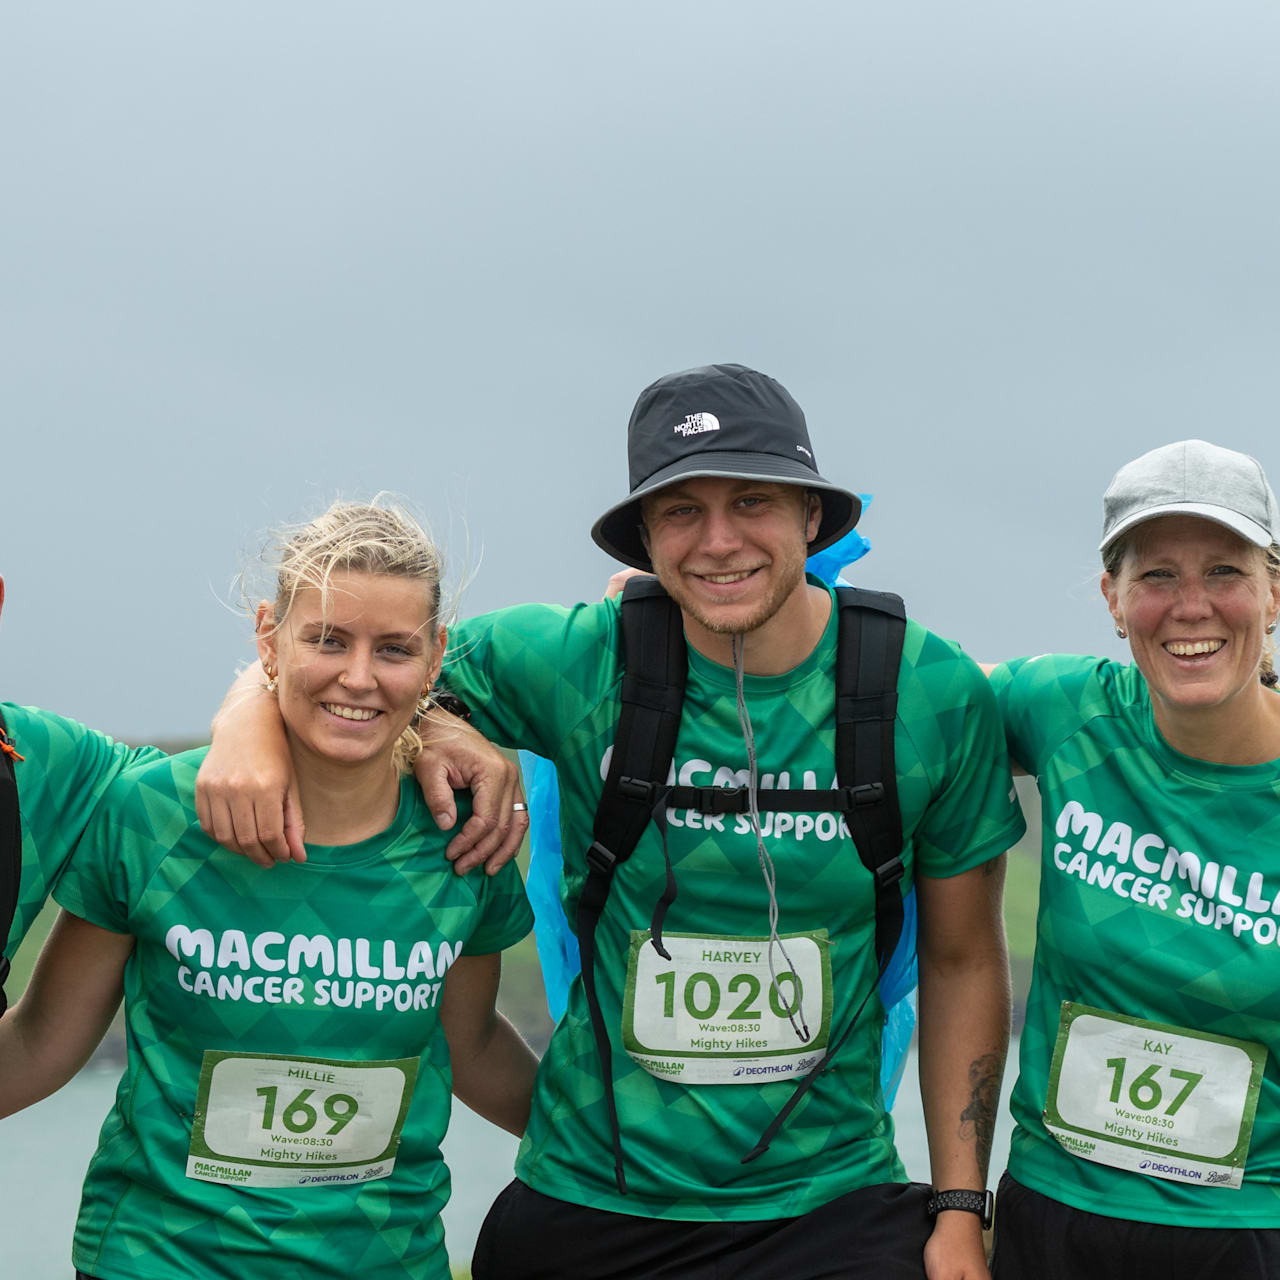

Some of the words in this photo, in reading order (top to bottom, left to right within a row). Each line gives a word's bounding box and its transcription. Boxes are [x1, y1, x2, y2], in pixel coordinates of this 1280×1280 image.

[674, 418, 703, 433] NORTH
[685, 413, 703, 423] THE
[682, 426, 704, 437] FACE
[666, 806, 726, 832] CER
[734, 808, 853, 842] SUPPOR
[1054, 841, 1172, 909] CANCER
[165, 923, 464, 982] MACMILLAN
[702, 950, 762, 963] HARVEY
[177, 965, 305, 1006] CANCER
[313, 978, 442, 1013] SUPPORT
[655, 970, 804, 1021] 1020
[698, 1023, 761, 1033] Wave:08:30
[690, 1037, 733, 1051] Mighty
[735, 1037, 768, 1049] Hikes
[1143, 1039, 1174, 1056] KAY
[287, 1068, 336, 1084] MILLIE
[746, 1064, 793, 1075] DECATHLON
[1106, 1057, 1204, 1117] 167
[255, 1085, 359, 1136] 169
[1114, 1107, 1175, 1129] Wave:08:30
[270, 1134, 333, 1147] Wave:08:30
[1054, 1132, 1096, 1151] ACMILLAN
[1104, 1120, 1144, 1141] Mighty
[1146, 1131, 1179, 1147] Hikes
[260, 1147, 302, 1162] Mighty
[305, 1150, 338, 1161] Hikes
[194, 1162, 252, 1177] MACMILLAN
[194, 1169, 218, 1178] CANCER
[219, 1174, 248, 1183] SUPPORT
[1151, 1162, 1202, 1179] DECATHLON
[311, 1173, 360, 1183] DECATHLON
